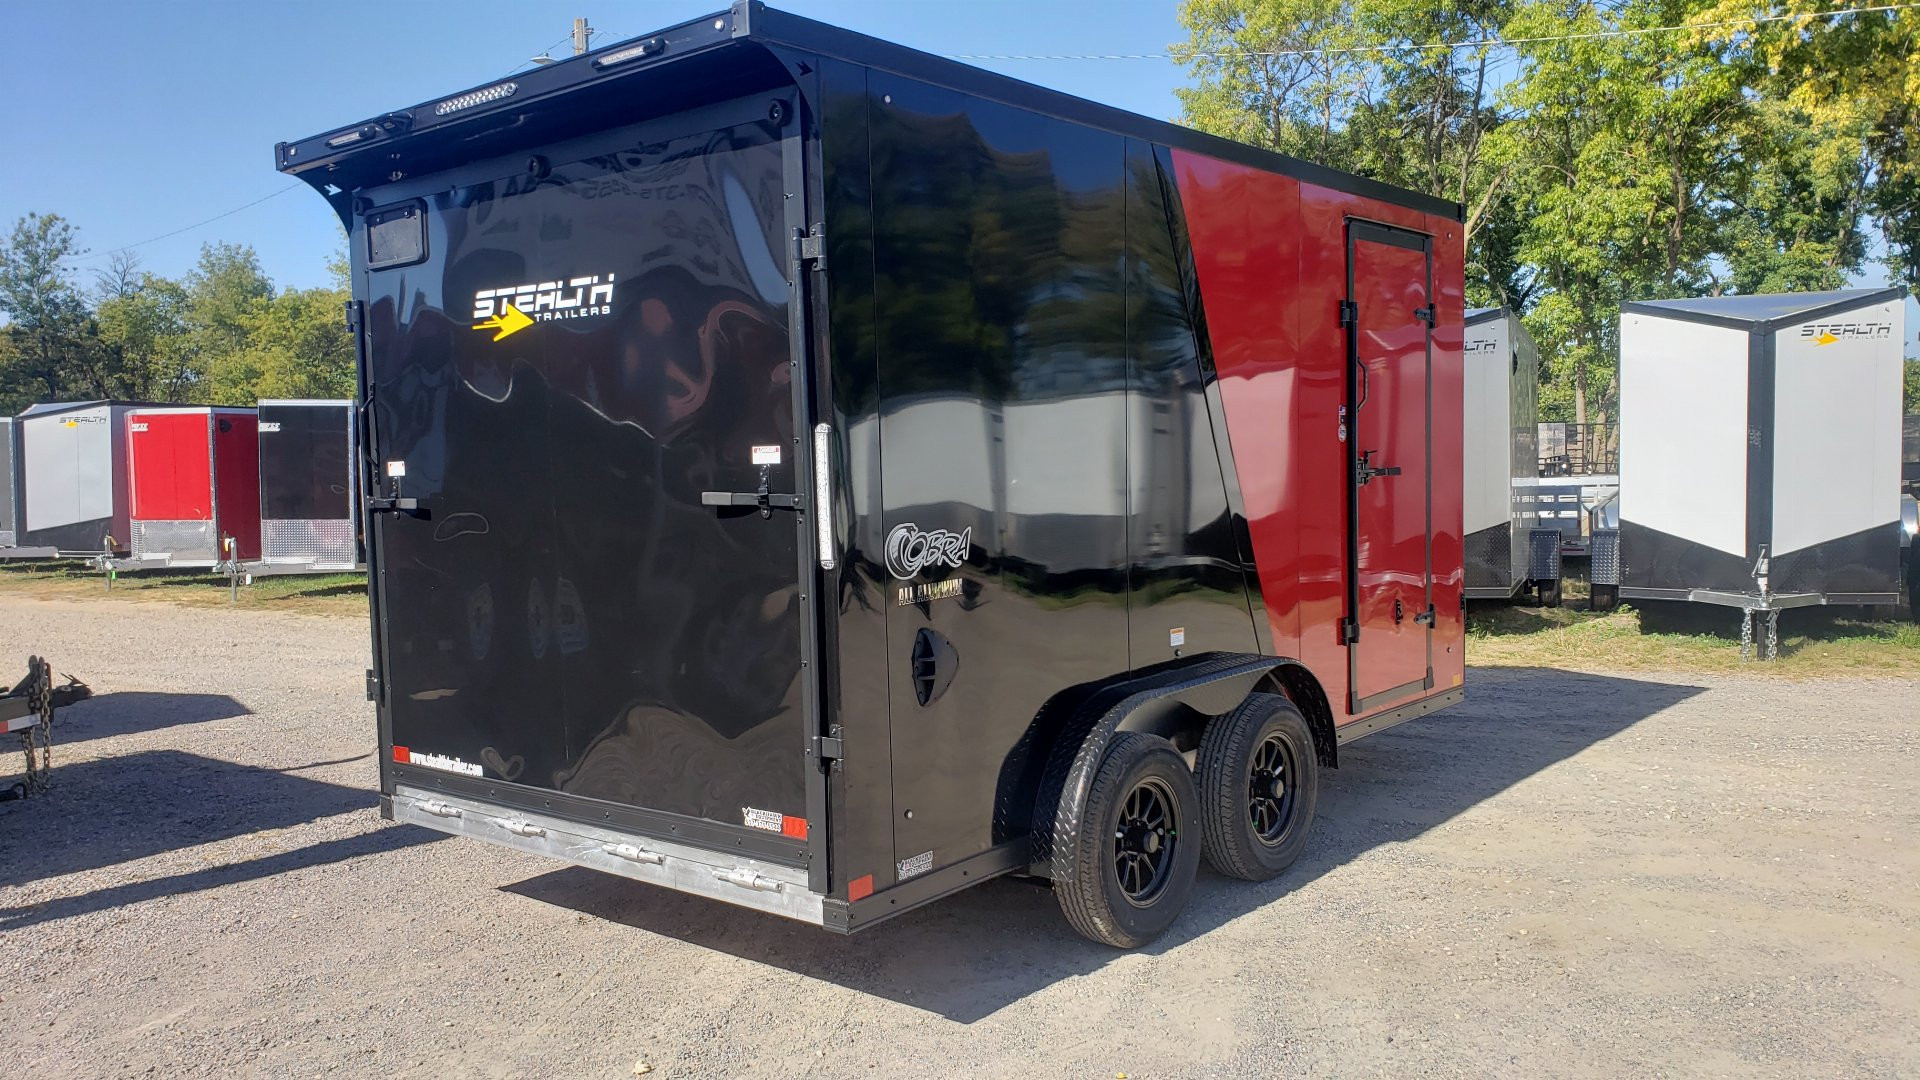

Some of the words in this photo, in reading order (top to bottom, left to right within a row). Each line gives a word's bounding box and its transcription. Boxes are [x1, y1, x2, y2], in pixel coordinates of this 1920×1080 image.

[473, 273, 615, 319] STEALTH
[534, 305, 611, 322] TRAILERS
[1801, 322, 1892, 336] STEALTH
[885, 523, 971, 580] COBRA
[899, 586, 915, 606] ALL
[917, 578, 963, 602] ALUMINUM
